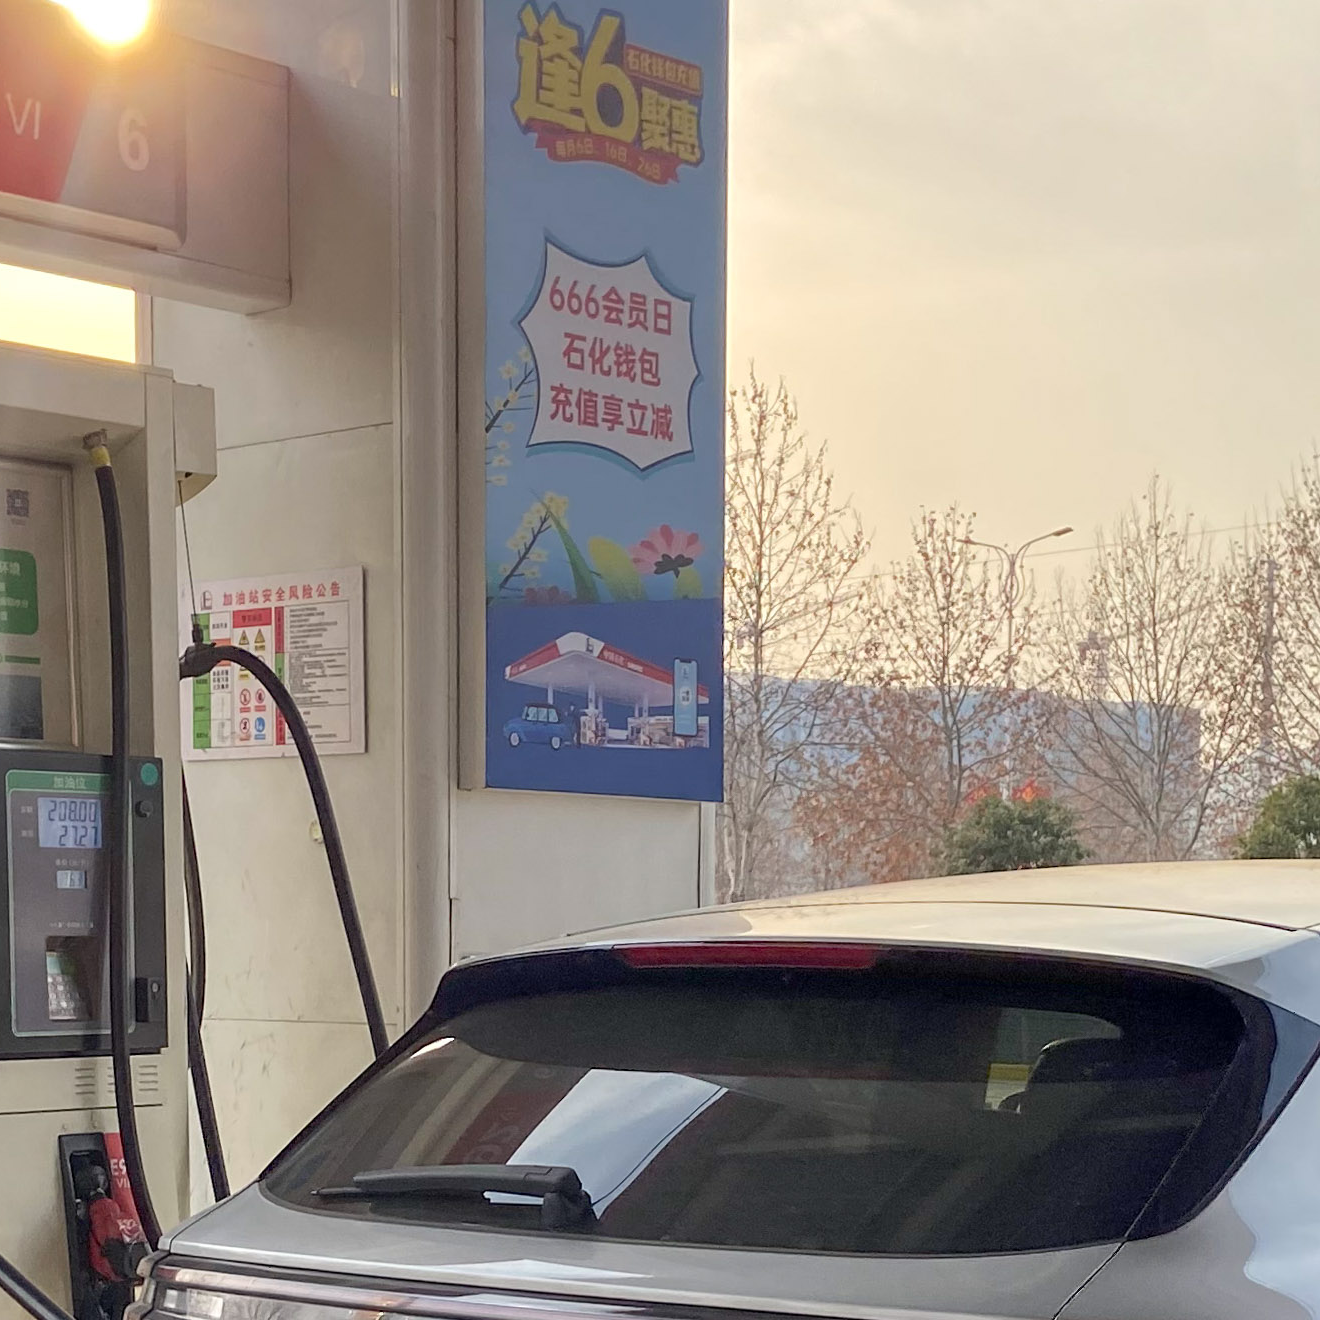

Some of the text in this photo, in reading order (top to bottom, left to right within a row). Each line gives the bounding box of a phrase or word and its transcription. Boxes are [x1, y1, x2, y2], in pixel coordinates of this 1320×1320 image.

[118, 104, 151, 171] 6
[549, 275, 672, 336] 666会员日
[562, 331, 662, 388] 石化钱包
[549, 382, 674, 442] 充值享立减
[222, 580, 341, 607] 加油站安全风险公告
[52, 775, 88, 790] 加油位
[48, 800, 98, 823] 208.00
[58, 825, 99, 847] 27.27
